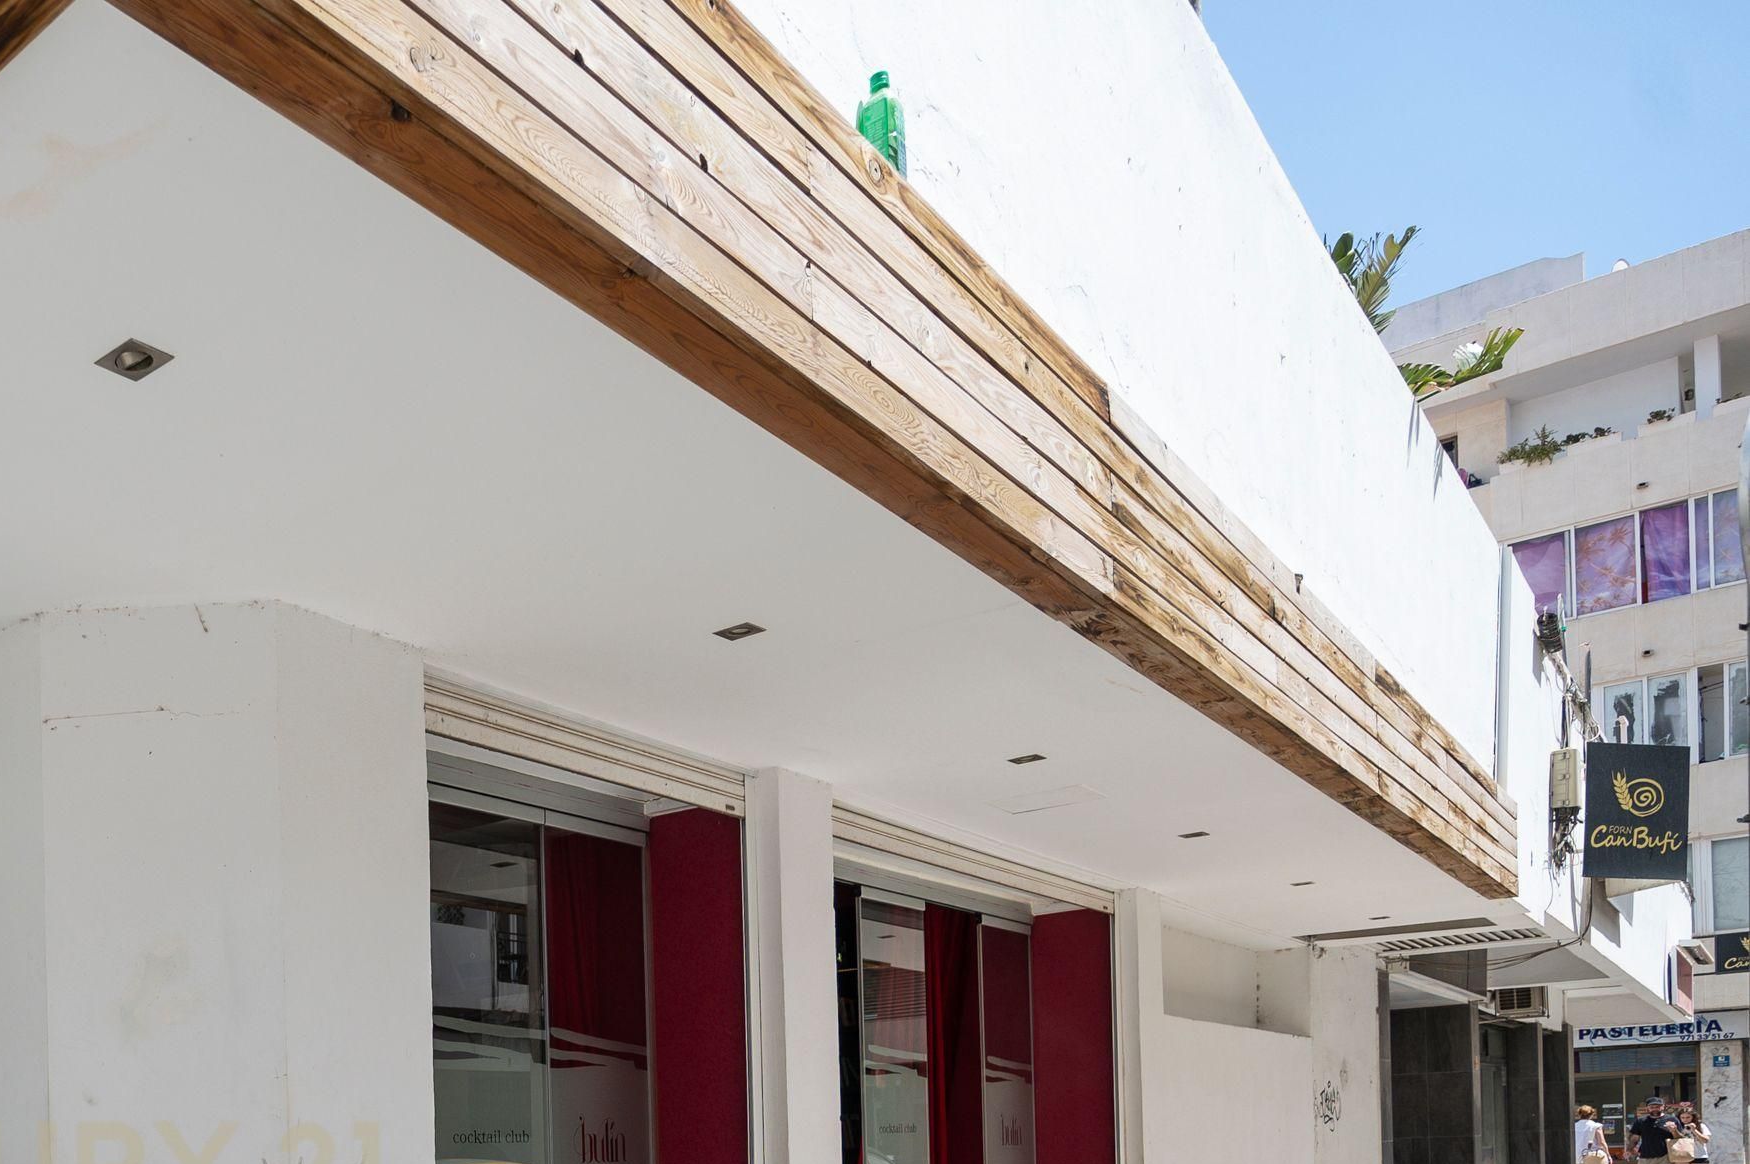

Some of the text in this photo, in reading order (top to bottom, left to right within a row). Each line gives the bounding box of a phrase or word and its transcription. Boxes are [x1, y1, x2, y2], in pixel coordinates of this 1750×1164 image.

[1608, 825, 1633, 834] FORN
[452, 1129, 530, 1145] cocktail club
